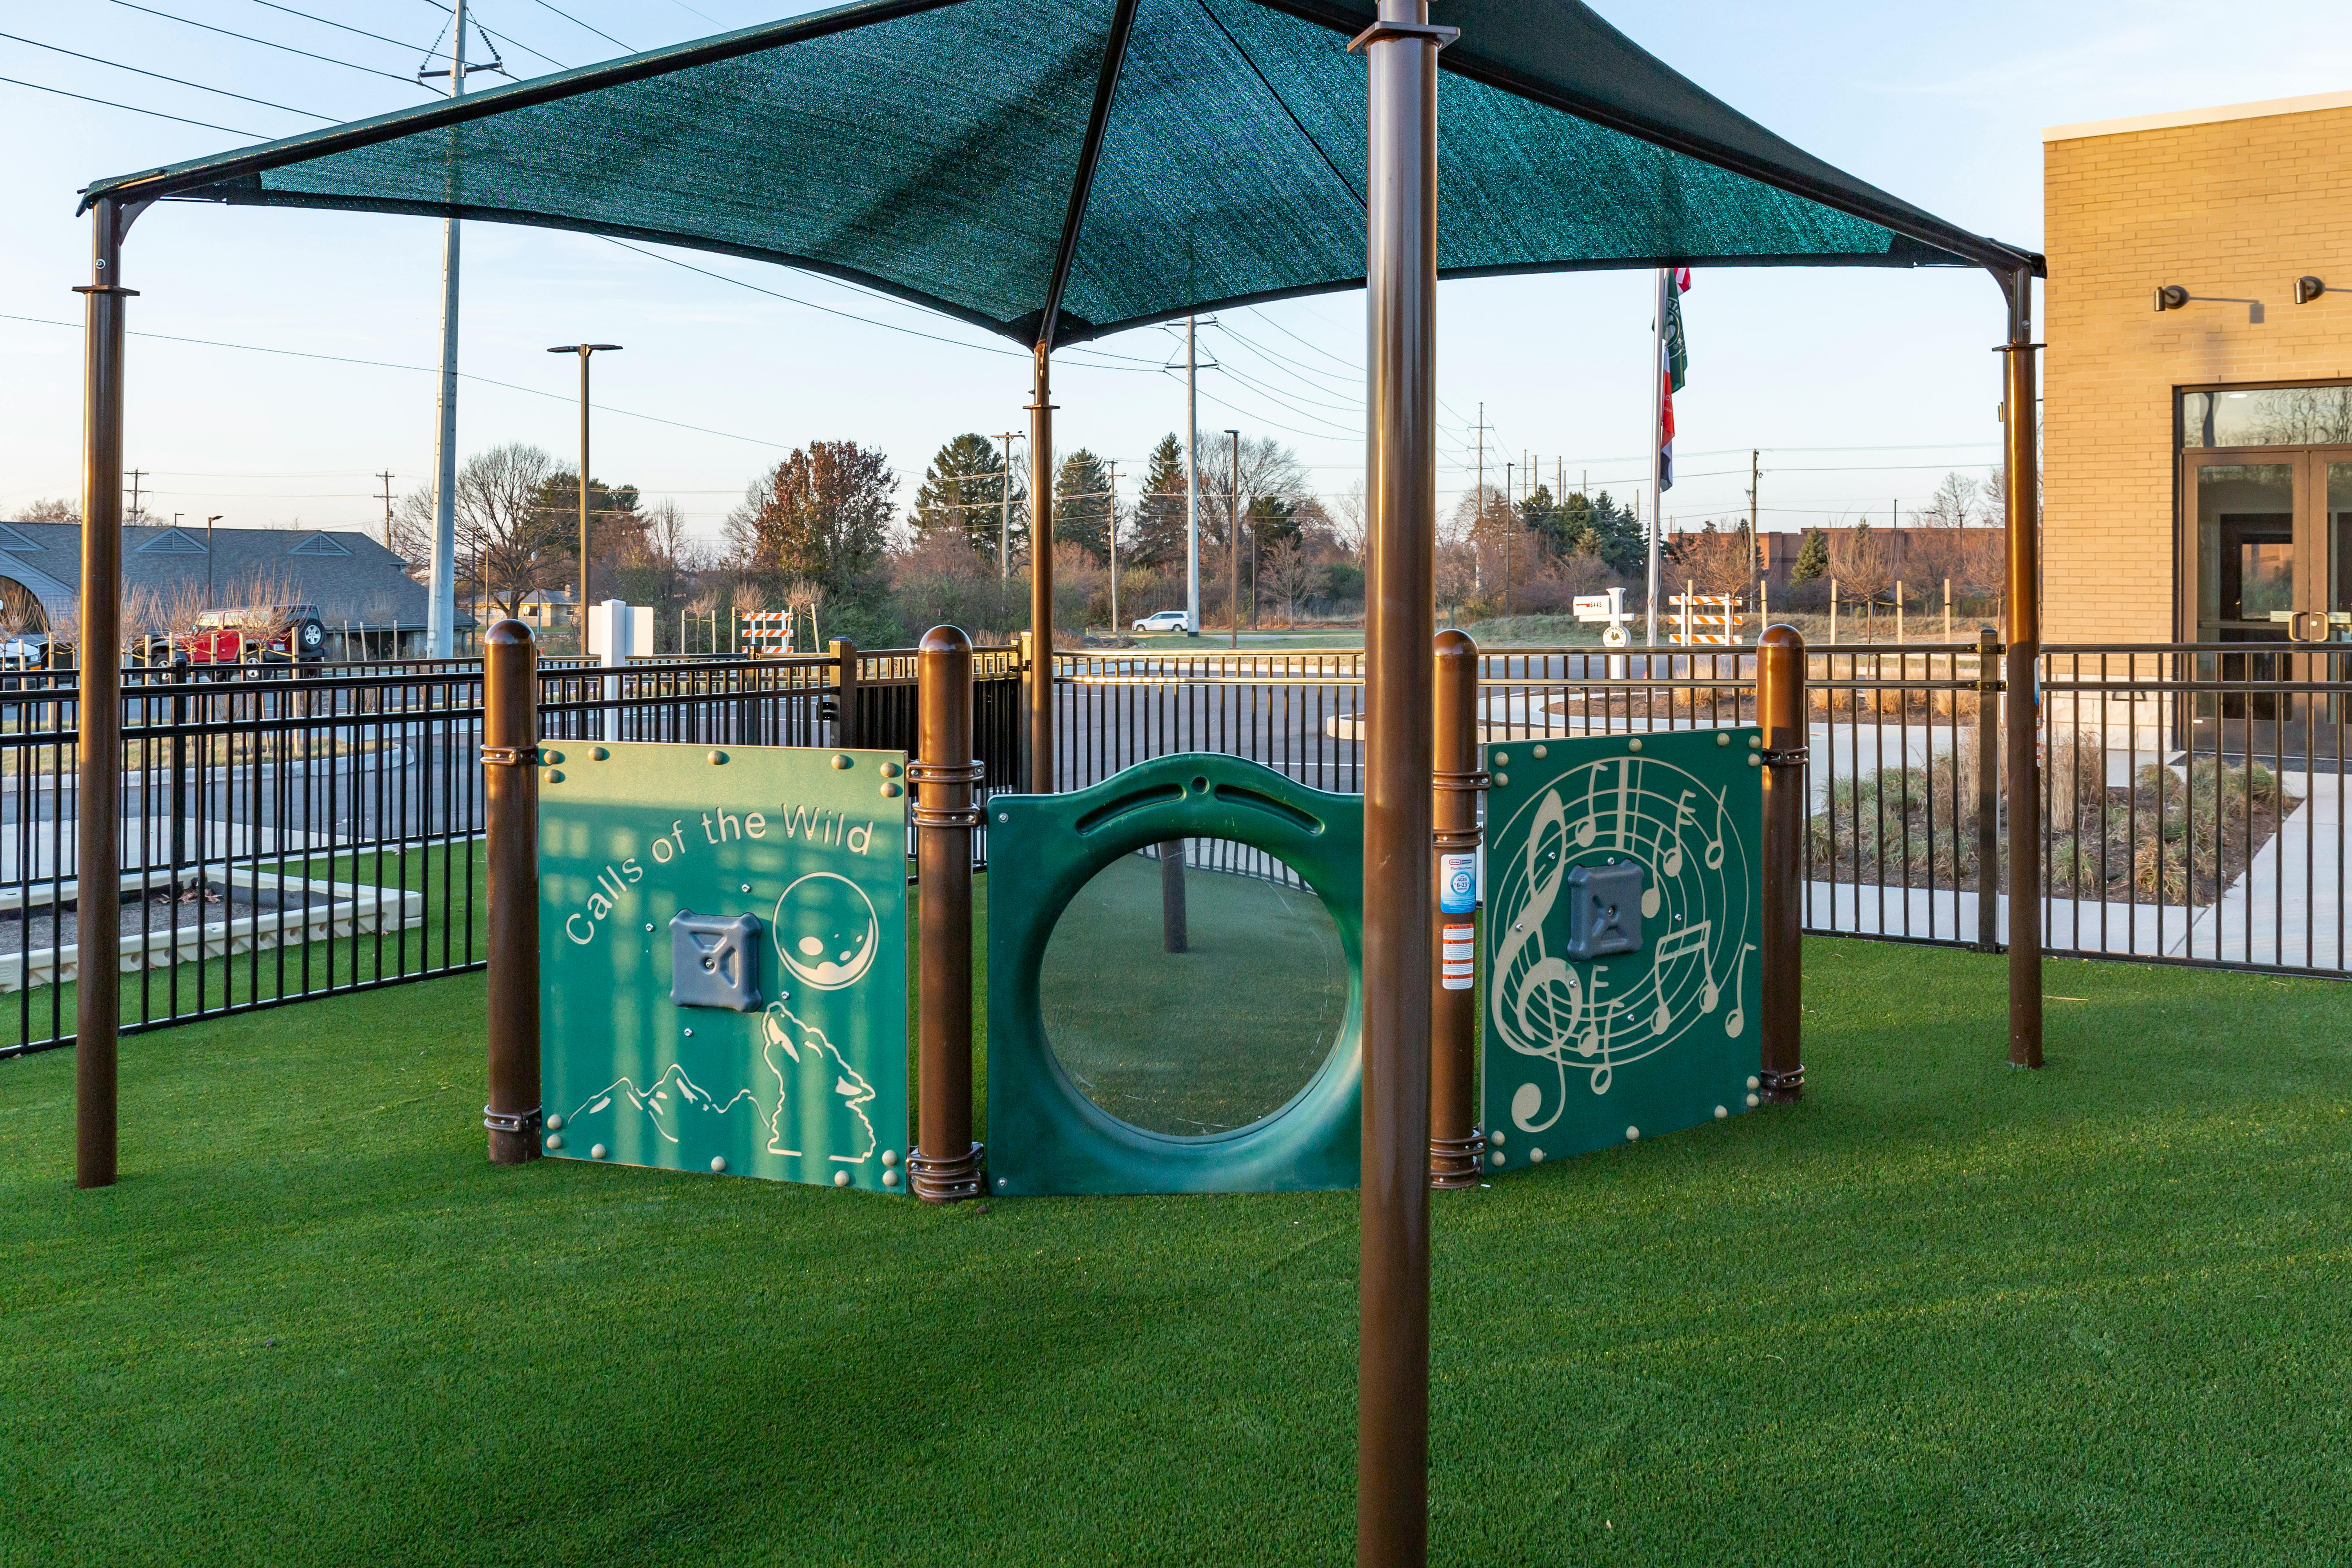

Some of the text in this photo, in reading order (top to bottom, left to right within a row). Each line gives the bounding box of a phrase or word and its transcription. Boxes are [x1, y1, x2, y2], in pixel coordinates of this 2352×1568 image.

[566, 803, 873, 944] Calls of the Wild
